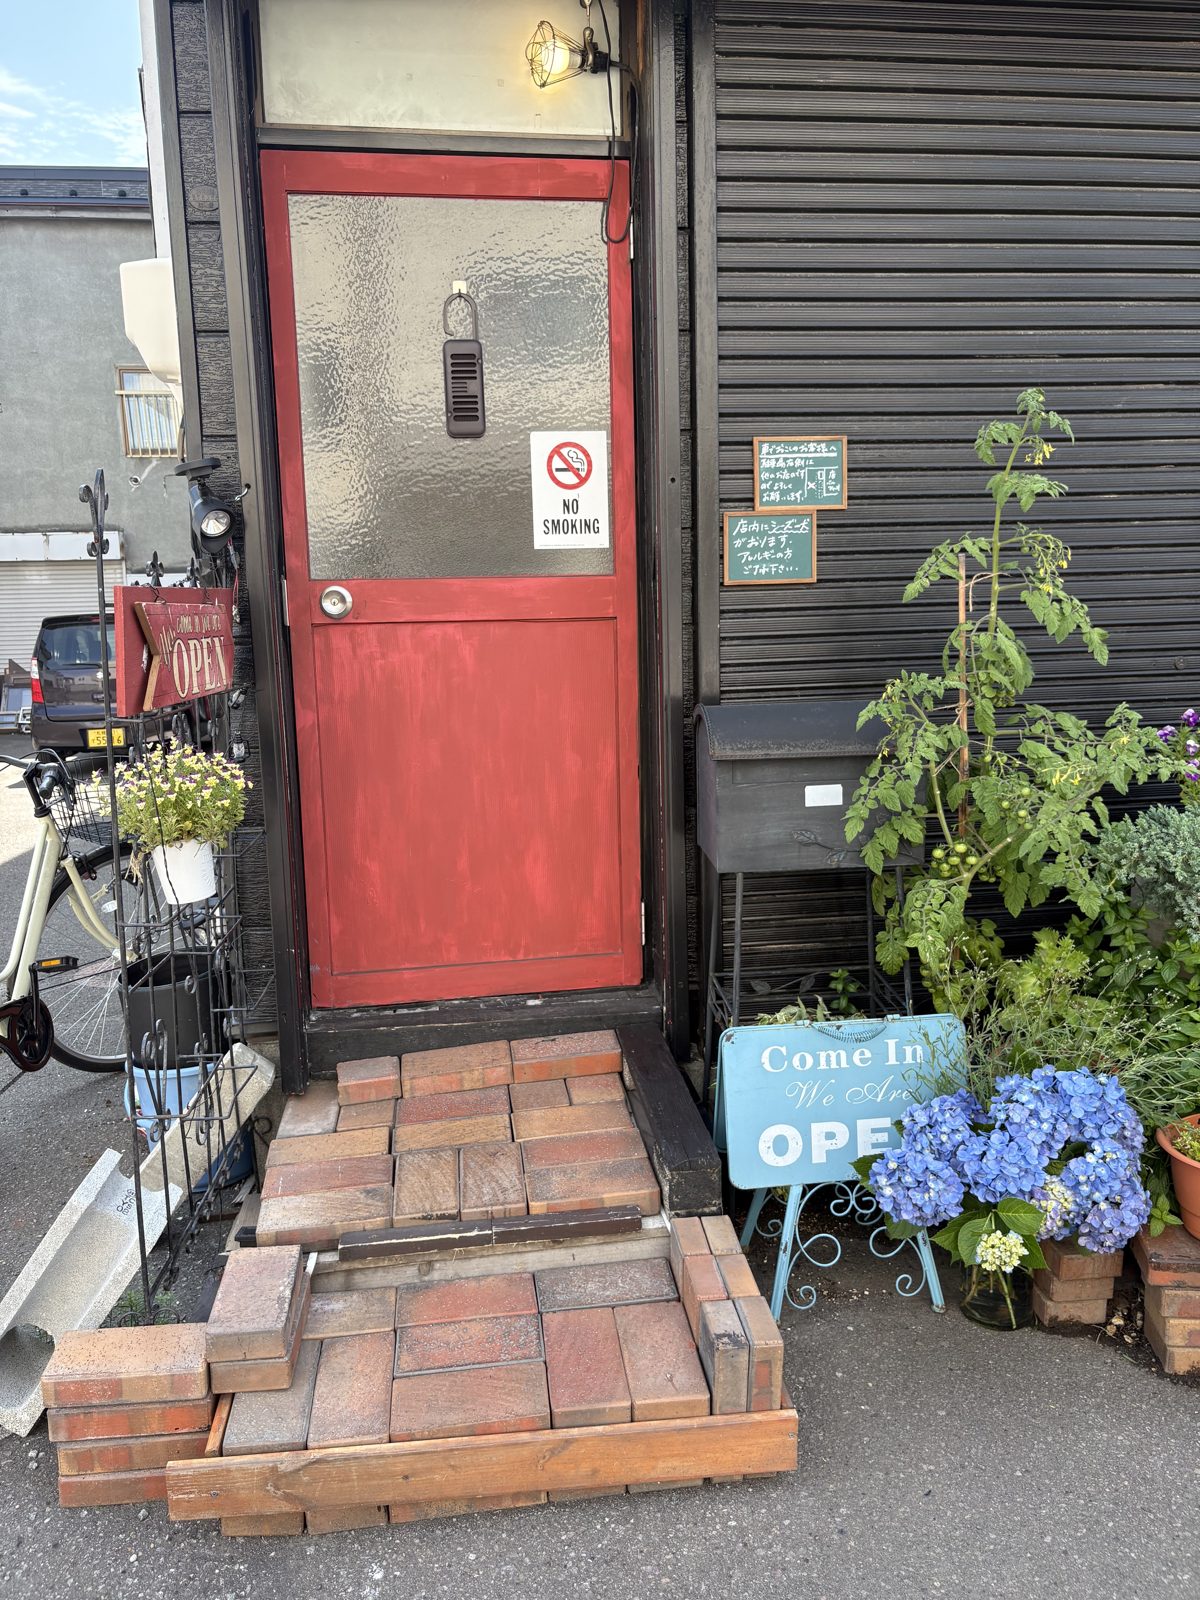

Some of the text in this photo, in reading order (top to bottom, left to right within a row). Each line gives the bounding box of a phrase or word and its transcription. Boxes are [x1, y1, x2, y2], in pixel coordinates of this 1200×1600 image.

[562, 498, 579, 515] NO
[543, 518, 600, 535] SMOKING
[172, 636, 226, 698] OPEN
[760, 1038, 925, 1073] Come In
[785, 1074, 913, 1109] We Are
[758, 1117, 893, 1167] OPE
